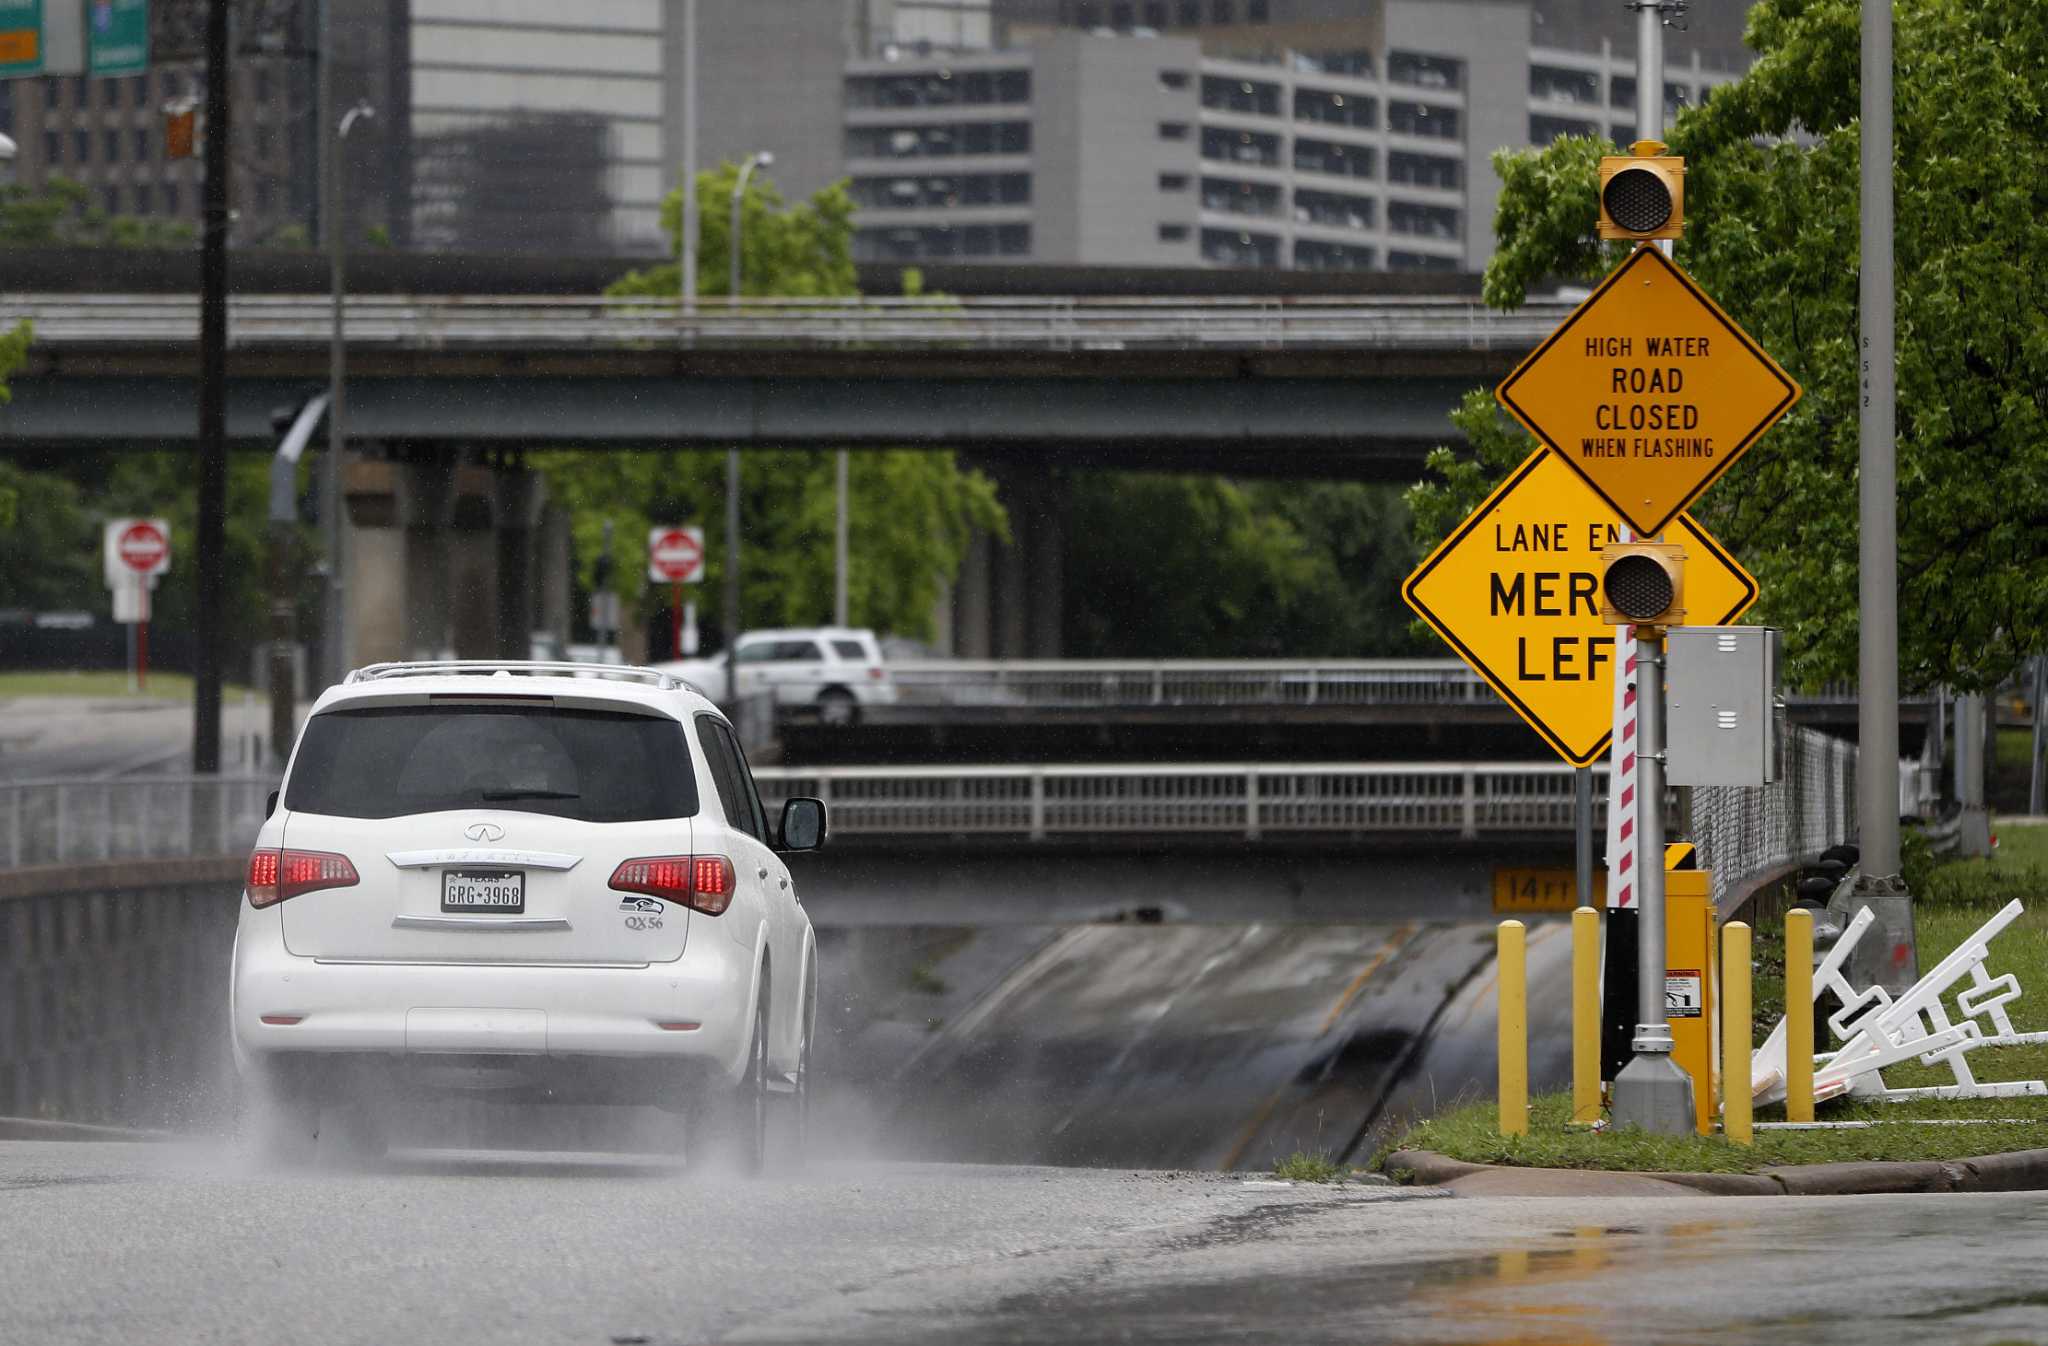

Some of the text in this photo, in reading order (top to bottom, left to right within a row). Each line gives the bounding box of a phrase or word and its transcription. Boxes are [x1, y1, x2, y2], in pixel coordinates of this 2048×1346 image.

[1585, 337, 1710, 357] HIGH WATER
[1612, 367, 1683, 394] ROAD
[1596, 404, 1699, 430] CLOSED
[1582, 438, 1713, 458] WHEN FLASHING
[1496, 523, 1620, 552] LANE EN
[1490, 572, 1600, 617] MER
[1518, 636, 1616, 681] LEF
